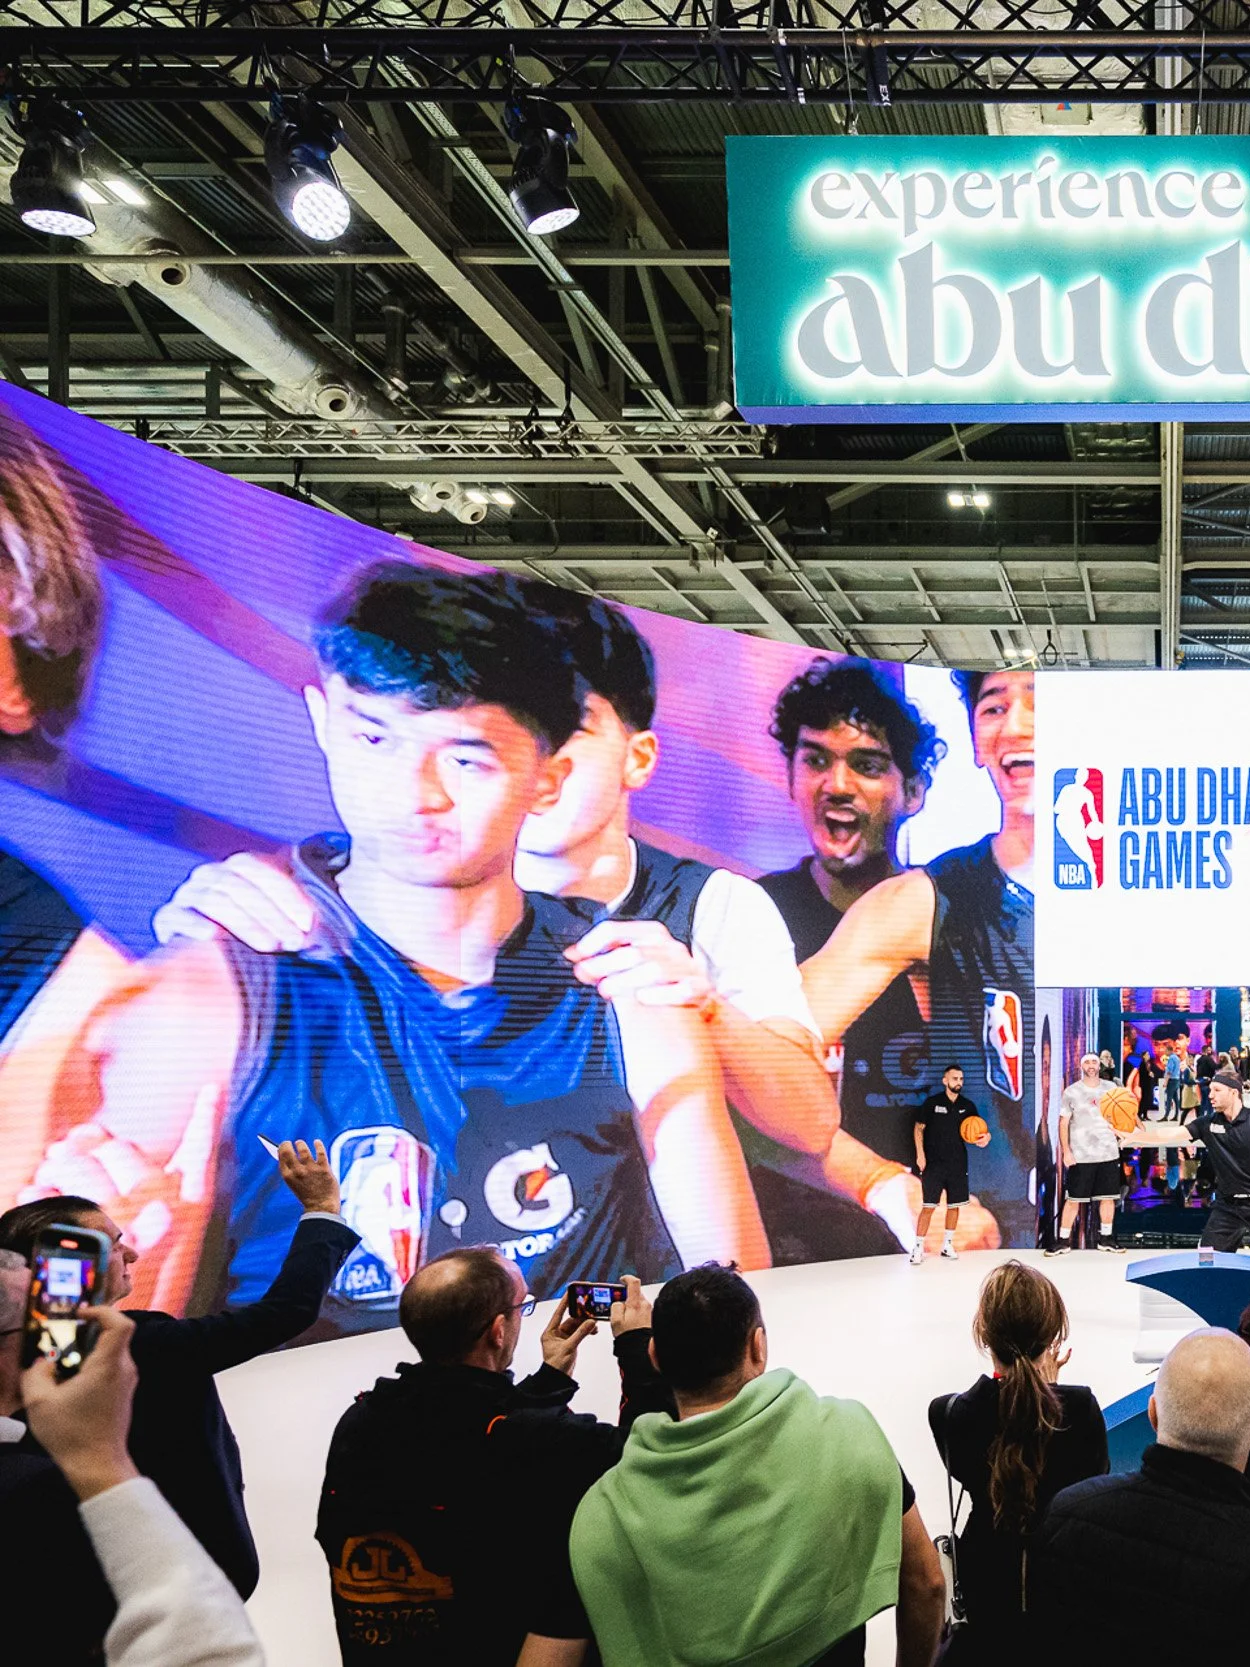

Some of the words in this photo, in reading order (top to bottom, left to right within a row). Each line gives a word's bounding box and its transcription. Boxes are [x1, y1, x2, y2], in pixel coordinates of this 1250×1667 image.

[796, 239, 1113, 379] abu
[1118, 766, 1186, 826] ABU
[1058, 863, 1086, 885] NBA
[1119, 830, 1233, 890] GAMES
